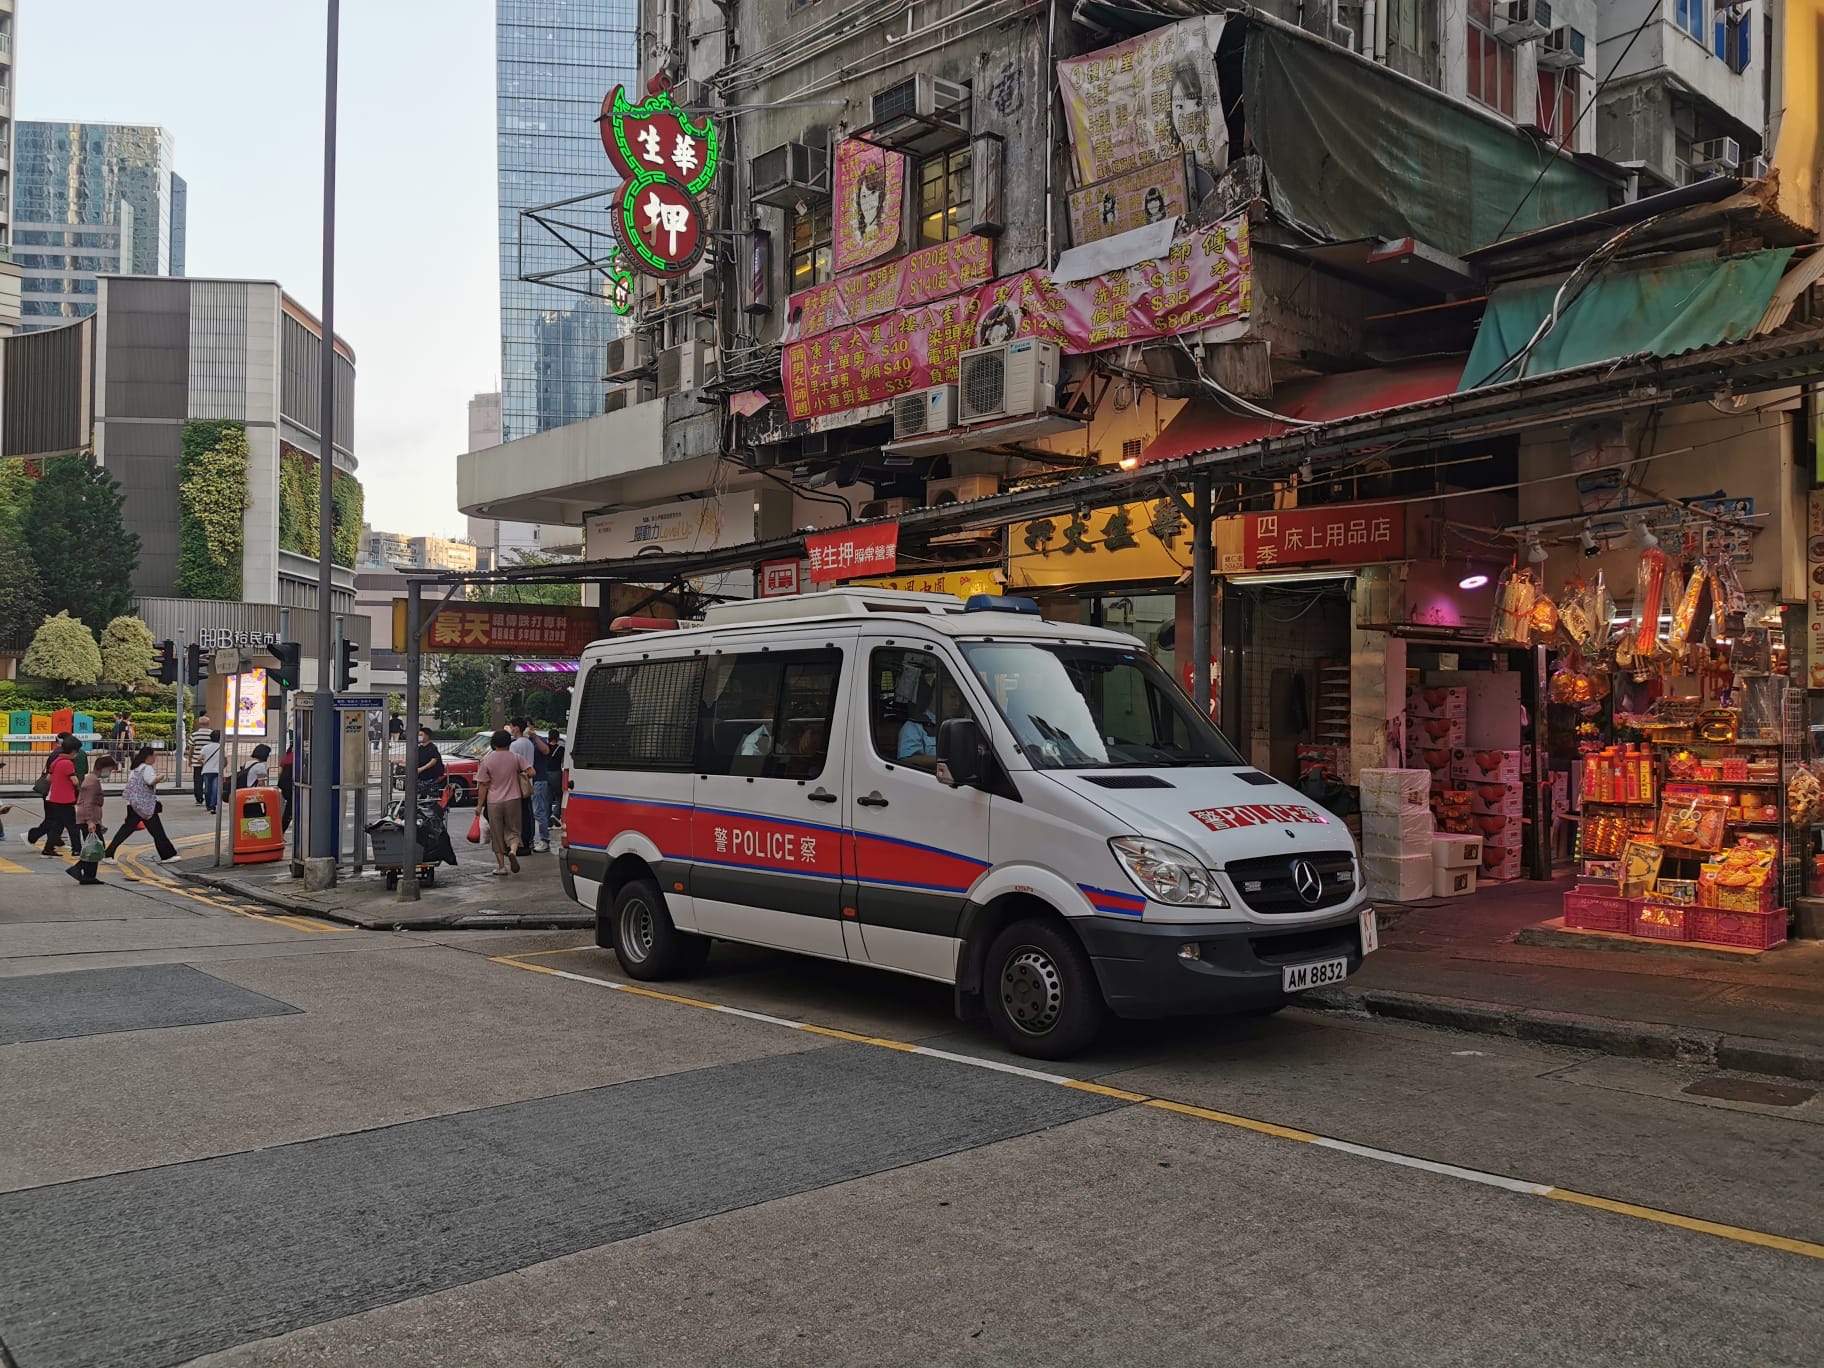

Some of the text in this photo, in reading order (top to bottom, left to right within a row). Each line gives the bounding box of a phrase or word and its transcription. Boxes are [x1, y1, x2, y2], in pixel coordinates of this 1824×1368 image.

[643, 191, 690, 257] 押
[1093, 280, 1129, 305] 洗頭
[1150, 266, 1190, 289] $35
[1091, 289, 1191, 327] 修眉 $35
[881, 339, 909, 357] $40
[883, 356, 912, 376] $40
[884, 376, 912, 394] $35
[1284, 518, 1391, 551] 床上用品店
[434, 612, 490, 645] 豪天
[1197, 808, 1230, 831] 警
[1221, 804, 1306, 828] POLICE
[713, 826, 817, 863] 警 POLICE 察
[1288, 962, 1344, 988] AM 8832
